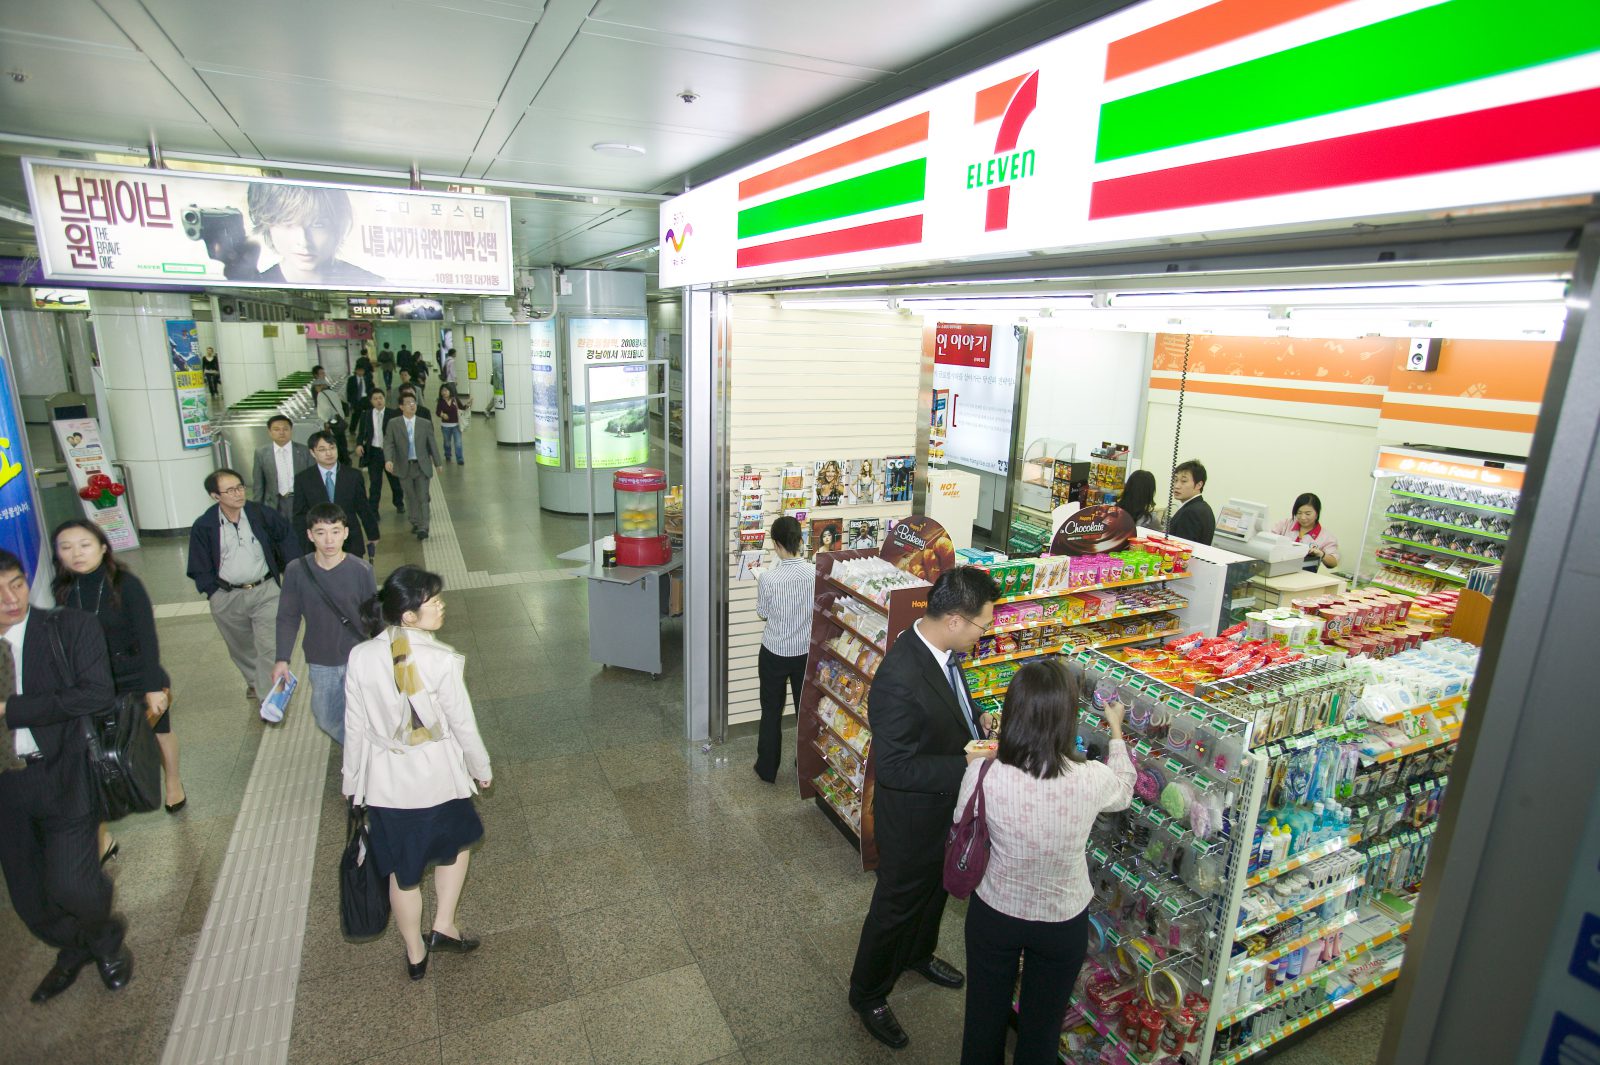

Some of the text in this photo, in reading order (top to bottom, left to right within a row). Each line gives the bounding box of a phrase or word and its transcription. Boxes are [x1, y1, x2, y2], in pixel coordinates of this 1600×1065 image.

[54, 175, 174, 229] 브레이브
[431, 203, 484, 219] 포스터
[94, 226, 109, 241] THE
[64, 223, 98, 270] 원
[96, 241, 122, 255] BRAVE
[361, 225, 498, 262] 나를 지키기 위한 마지막 선택
[99, 255, 115, 269] ONE
[436, 273, 500, 286] 10월 11일 대개봉
[950, 335, 987, 352] 이야기
[586, 350, 618, 360] 경남에서
[1065, 520, 1105, 535] Chocolate
[897, 524, 926, 551] Bakery
